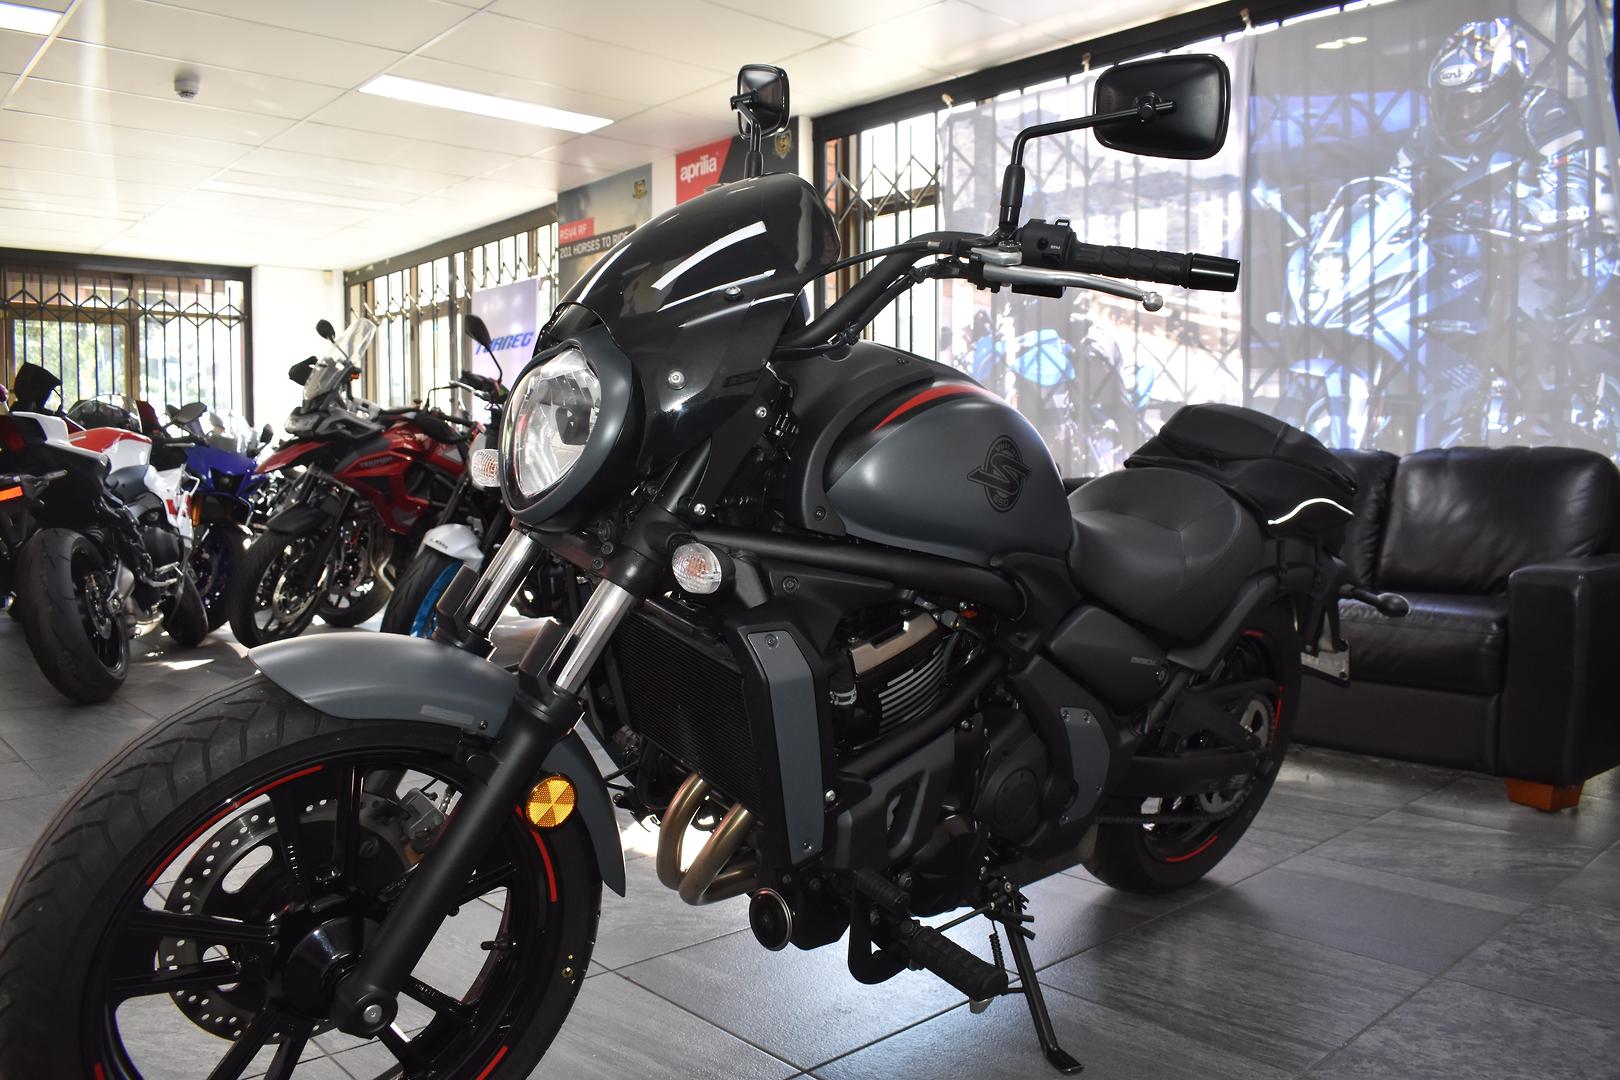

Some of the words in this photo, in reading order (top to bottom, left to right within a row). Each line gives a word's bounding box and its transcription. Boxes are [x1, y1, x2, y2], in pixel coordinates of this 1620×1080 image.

[680, 154, 717, 183] aprilia
[560, 246, 572, 259] 201
[573, 239, 600, 255] HORSES
[602, 235, 611, 248] TO
